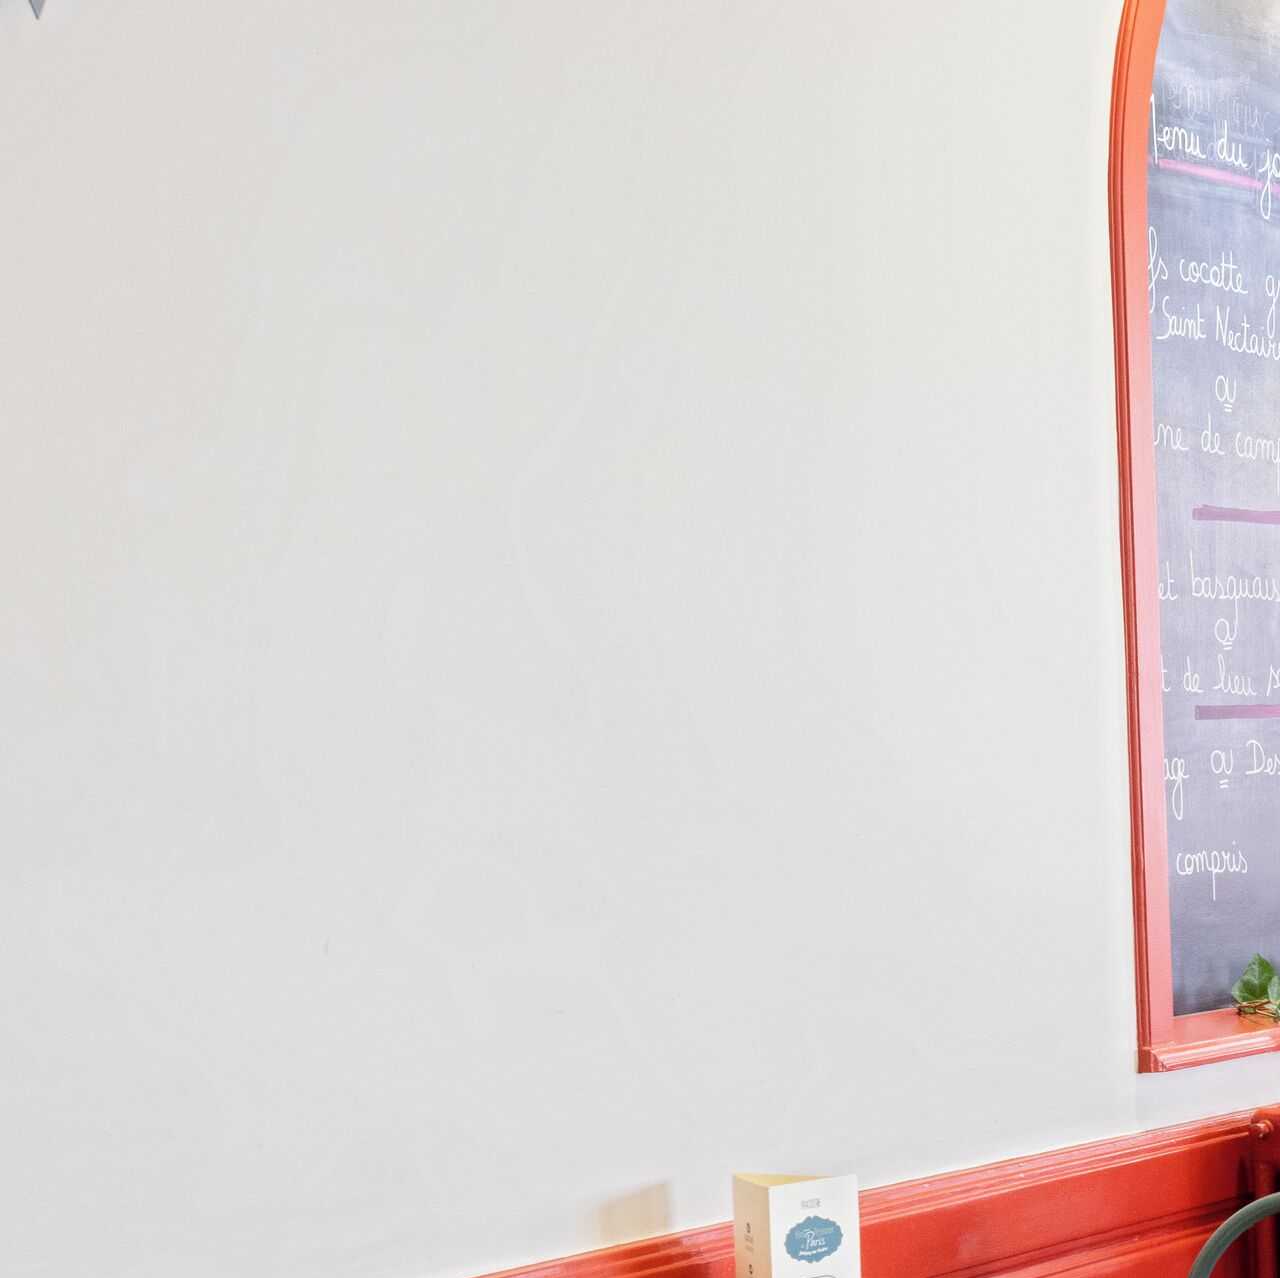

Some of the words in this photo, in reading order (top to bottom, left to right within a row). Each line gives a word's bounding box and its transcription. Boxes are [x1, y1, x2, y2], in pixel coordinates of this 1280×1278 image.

[1217, 120, 1248, 169] du
[1179, 251, 1249, 294] cocotte
[1156, 295, 1207, 340] Saint
[1201, 413, 1225, 455] de
[1183, 656, 1204, 694] de
[1213, 654, 1257, 697] lieu
[1176, 841, 1249, 901] compris
[805, 1230, 826, 1250] Paris
